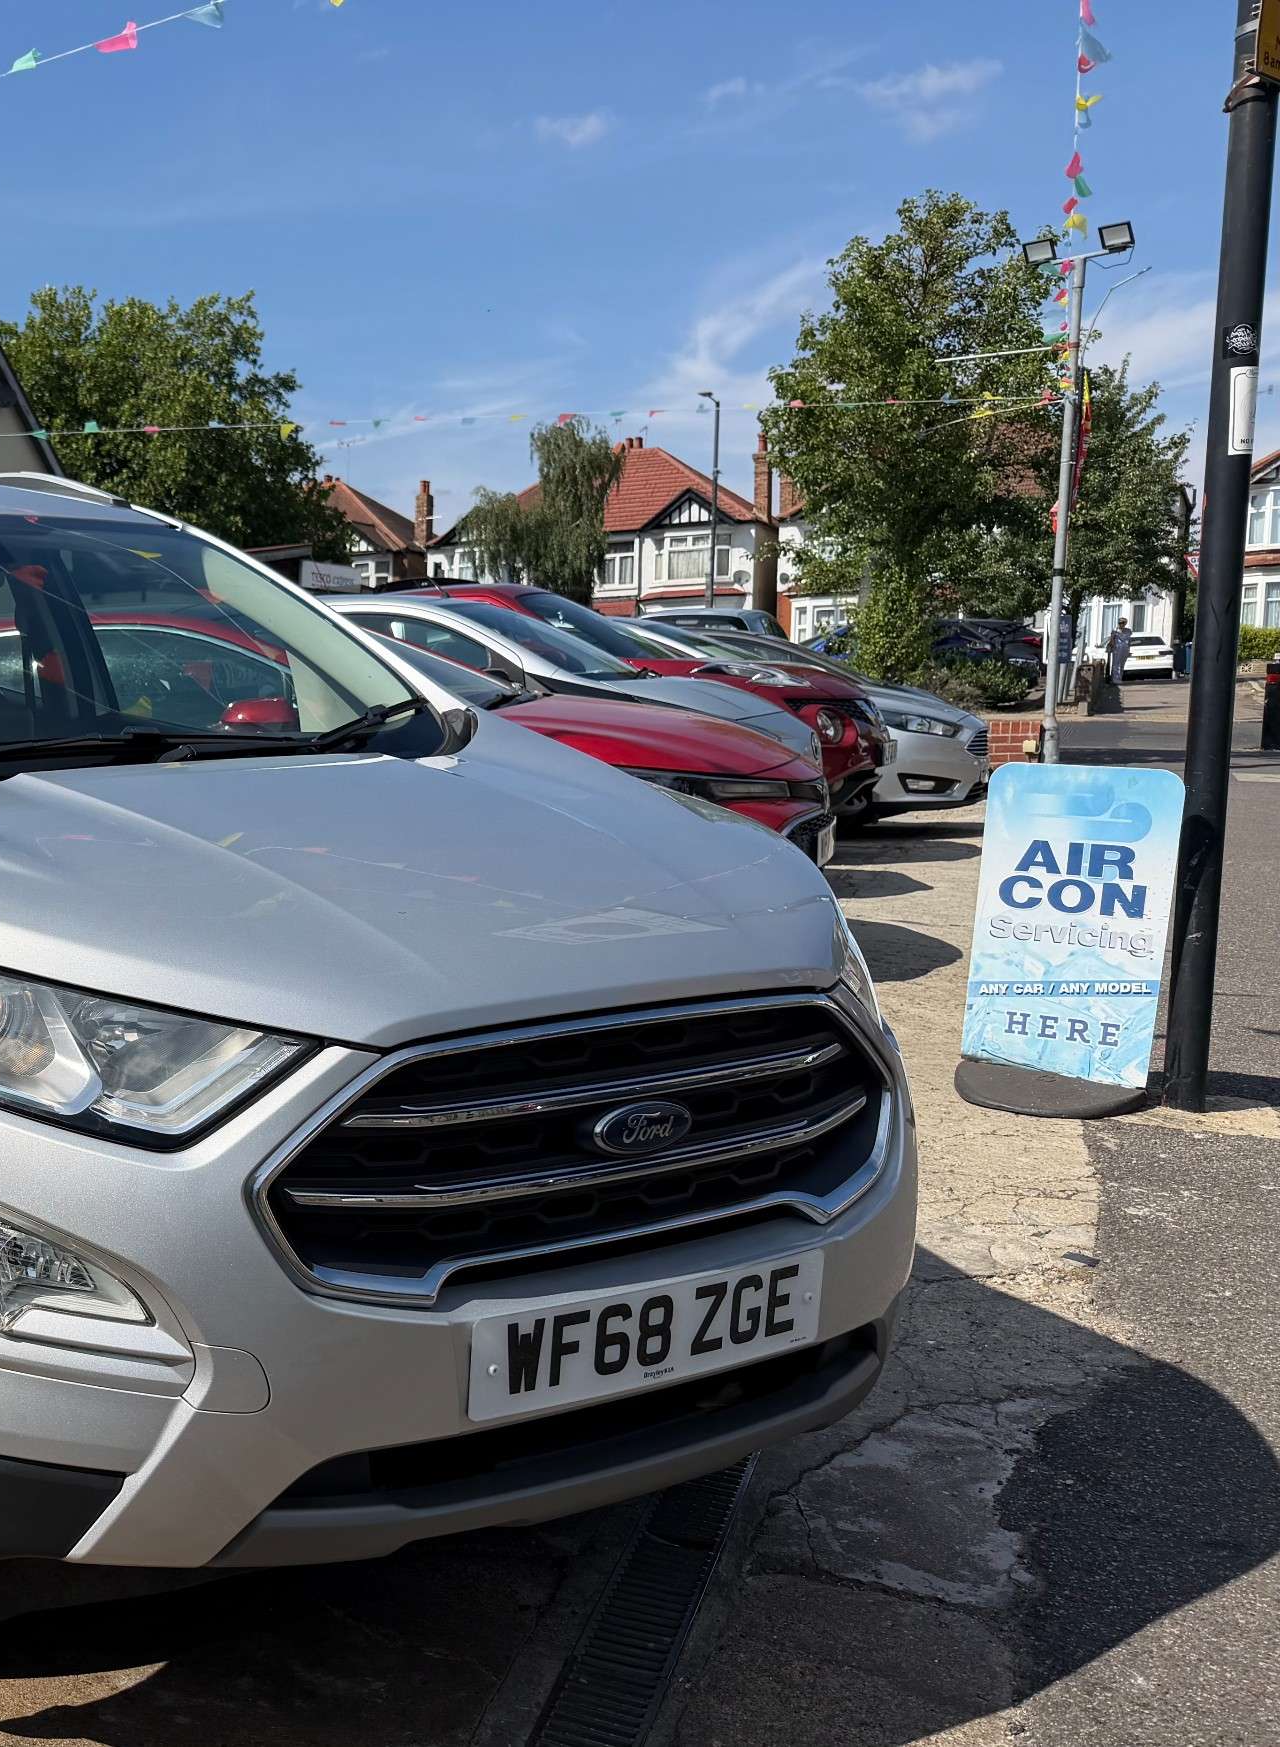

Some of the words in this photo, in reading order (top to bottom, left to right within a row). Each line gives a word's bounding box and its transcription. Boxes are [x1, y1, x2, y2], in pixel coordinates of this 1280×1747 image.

[1014, 839, 1136, 880] AIR
[998, 874, 1147, 919] CON
[989, 914, 1155, 958] Servicing
[979, 983, 1009, 995] ANY
[1013, 983, 1045, 995] CAR
[1059, 982, 1089, 995] ANY
[1094, 982, 1152, 995] MODEL
[1004, 1010, 1122, 1048] HERE
[623, 1111, 675, 1144] Ford
[507, 1294, 675, 1395] WF68
[689, 1263, 800, 1357] ZGE
